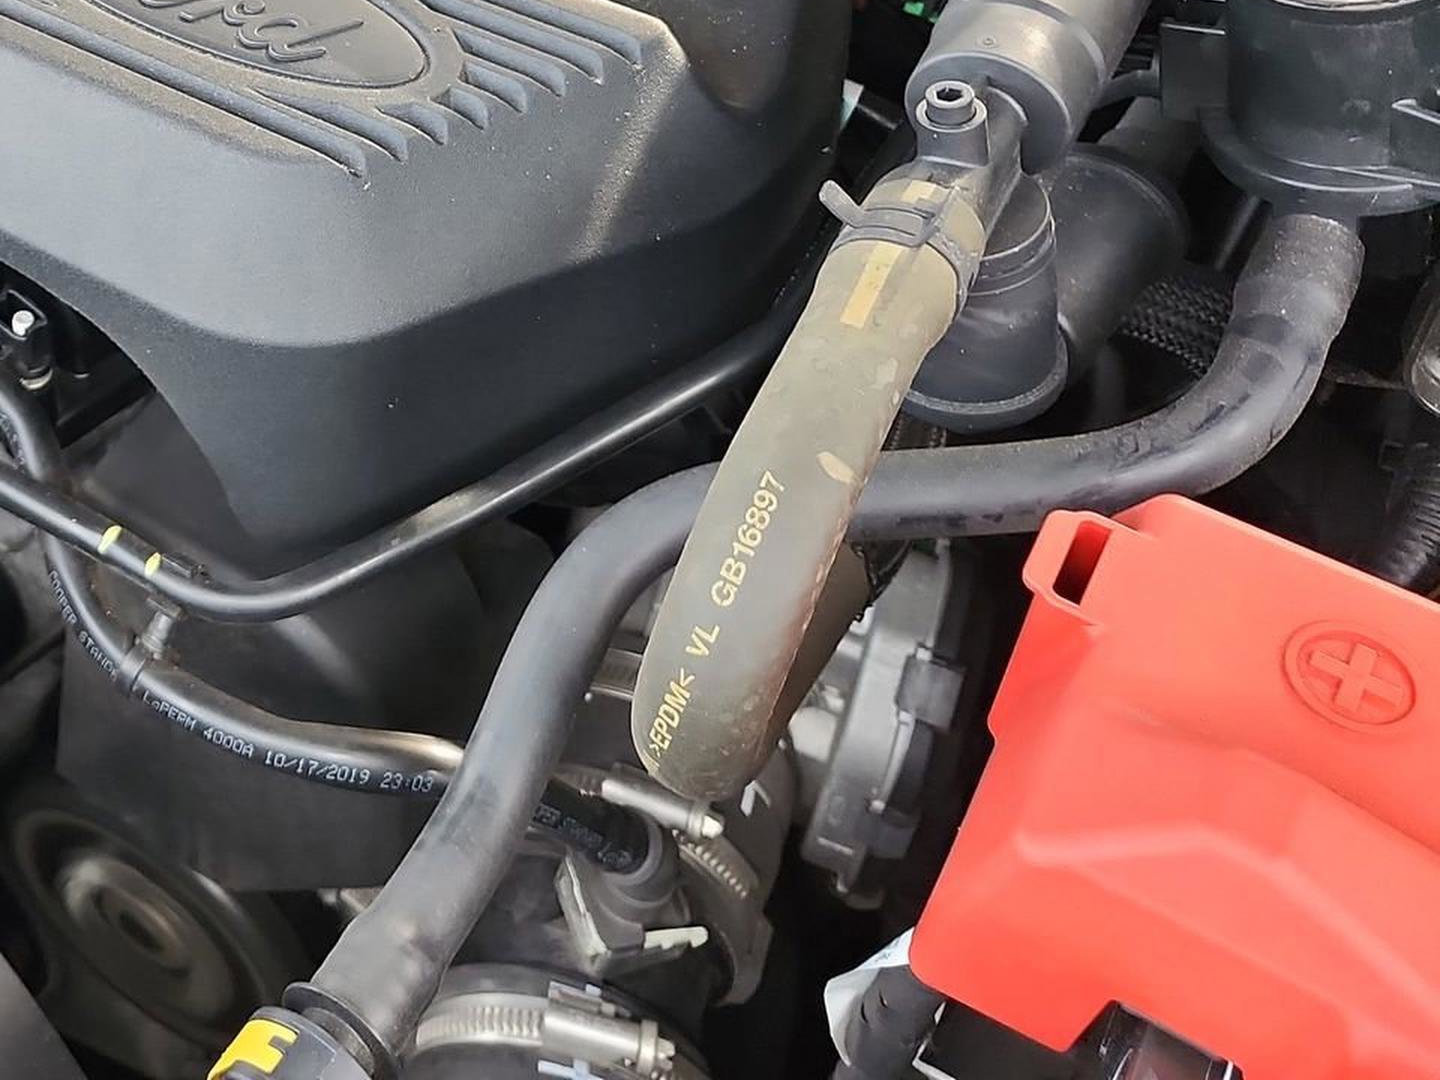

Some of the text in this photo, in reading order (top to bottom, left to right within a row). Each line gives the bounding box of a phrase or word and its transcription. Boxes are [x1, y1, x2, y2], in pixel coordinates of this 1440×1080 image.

[685, 623, 721, 658] VL
[711, 470, 785, 608] GB16897
[46, 569, 80, 626] COOPER
[202, 724, 256, 759] 4000A
[264, 749, 372, 786] 10/17/2019
[379, 771, 434, 794] 23:03
